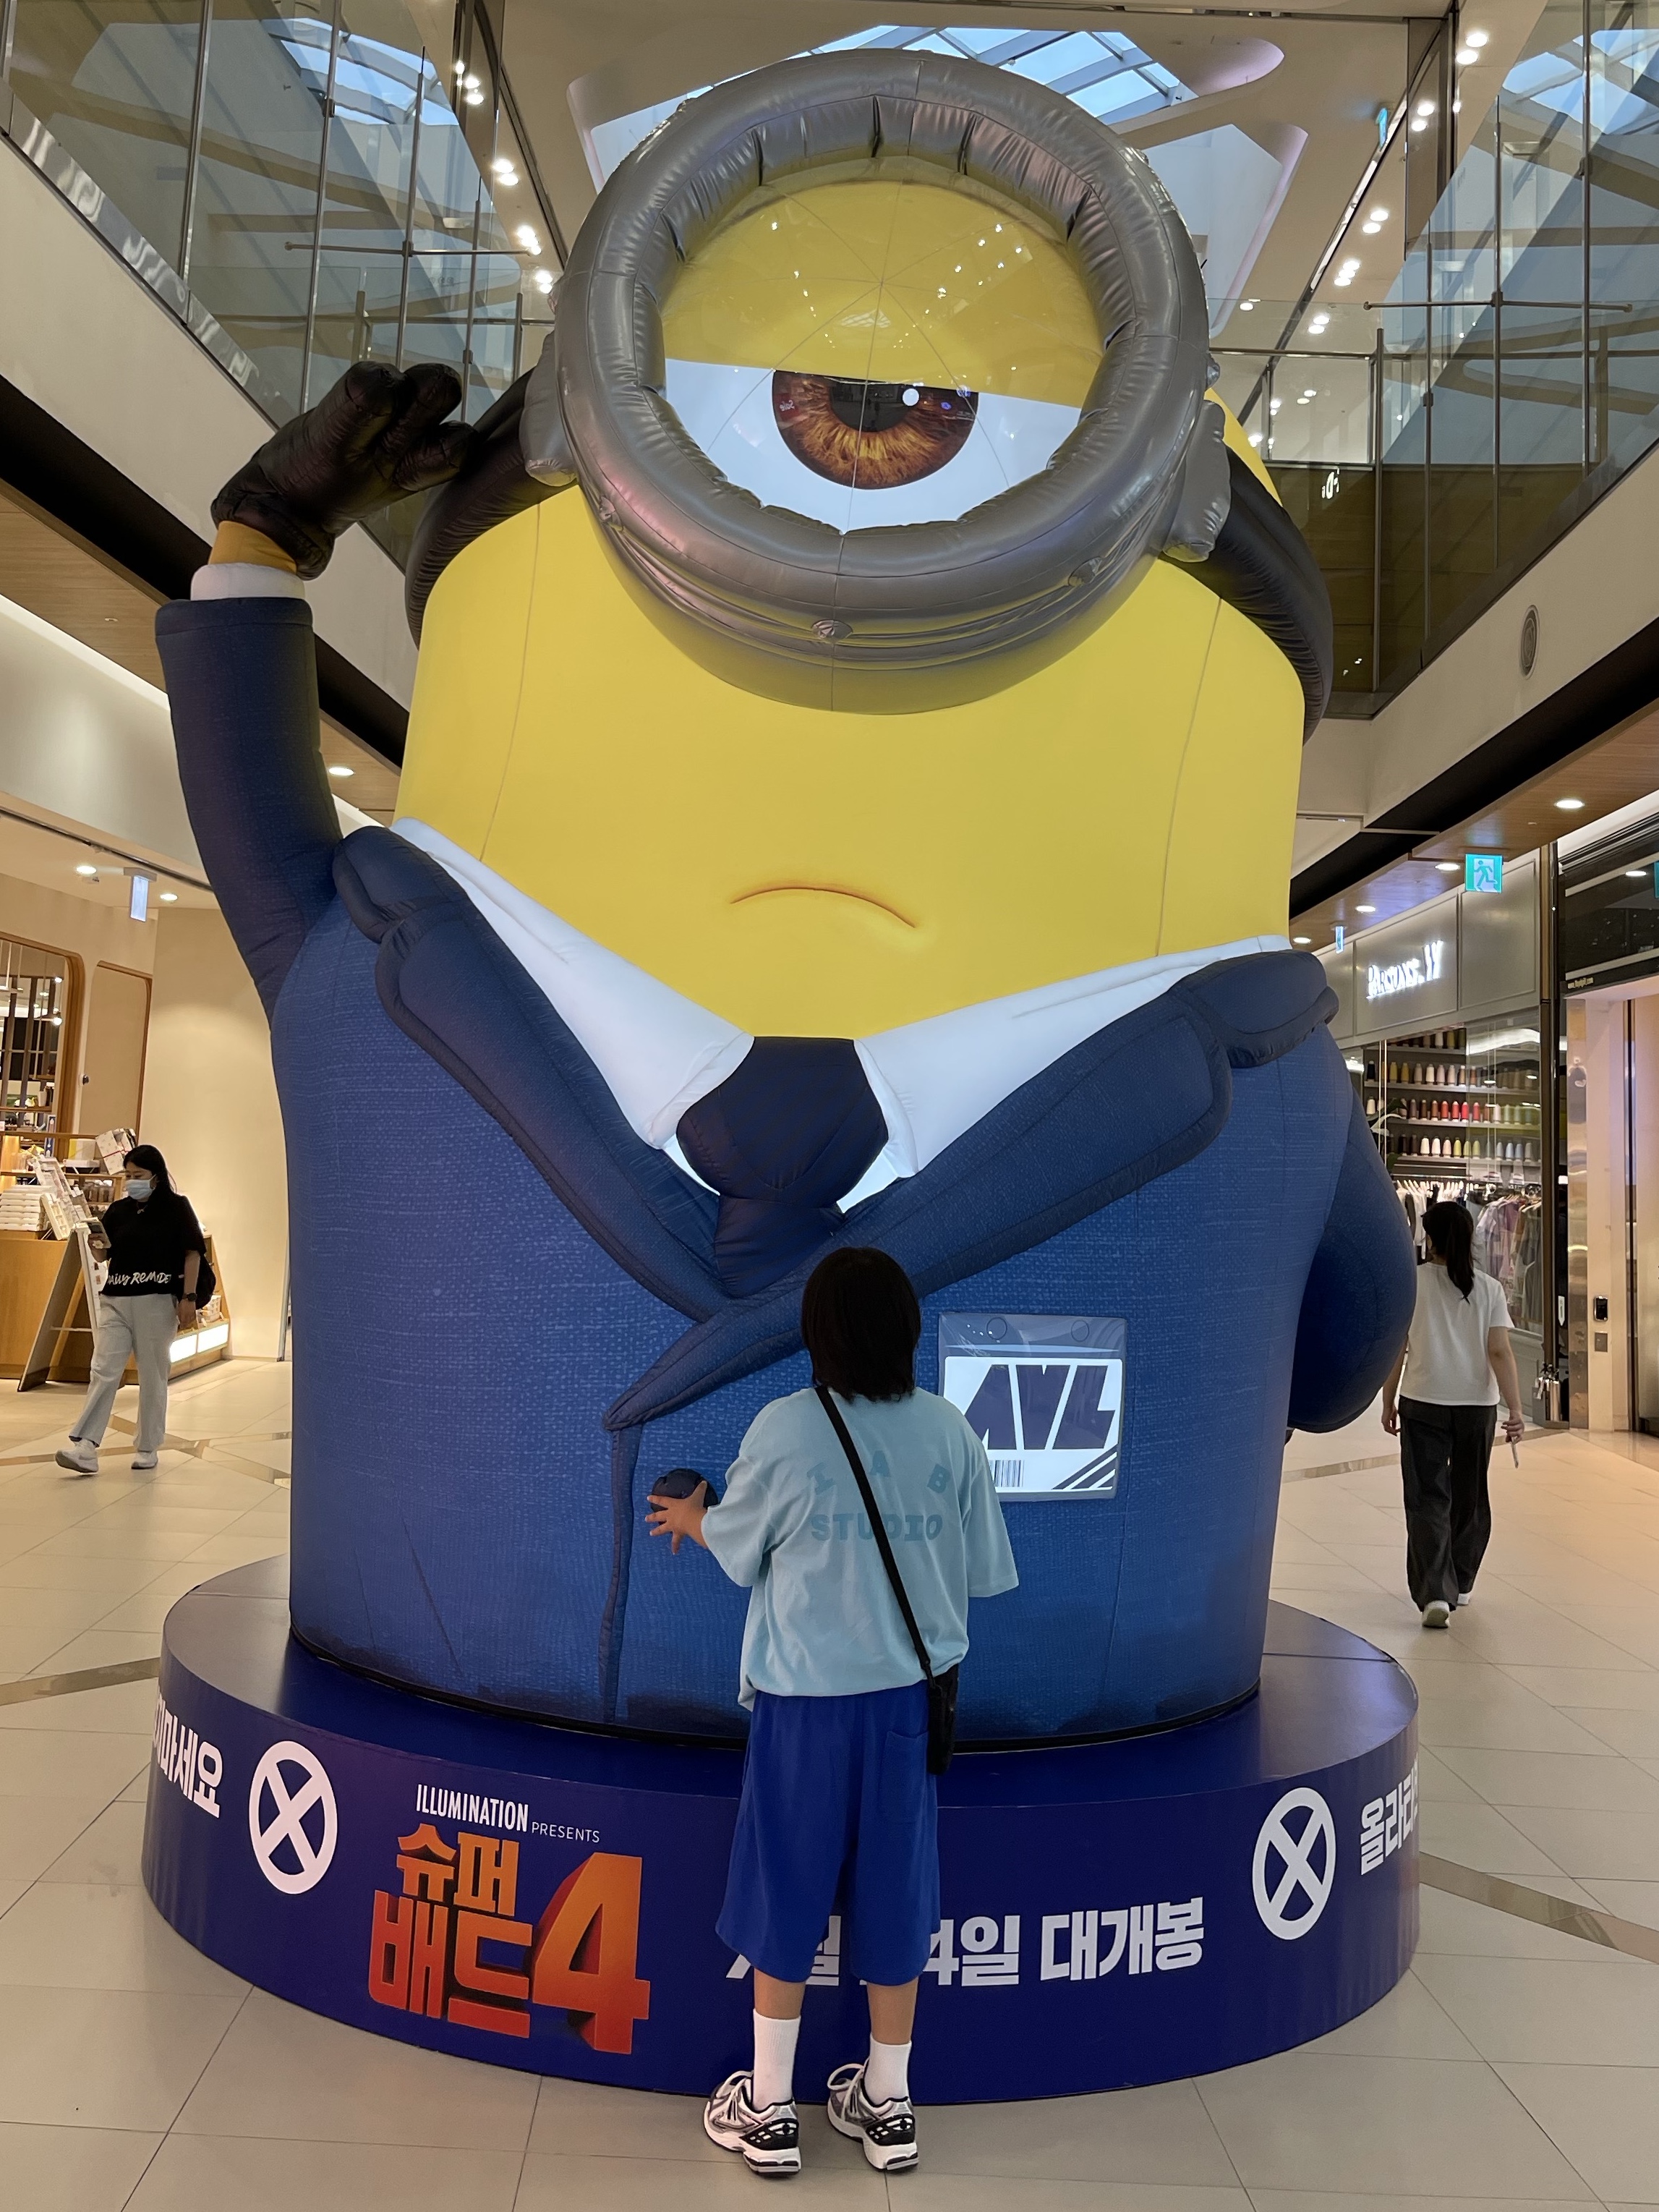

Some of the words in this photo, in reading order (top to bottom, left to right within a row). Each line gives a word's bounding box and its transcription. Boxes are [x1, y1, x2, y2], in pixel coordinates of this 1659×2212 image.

[810, 1513, 943, 1541] STUDIO
[416, 1784, 529, 1832] ILLUMINATION
[532, 1821, 600, 1844] PRESENTS
[396, 1823, 519, 1916] 슈퍼
[1041, 1897, 1204, 1981] 대개봉
